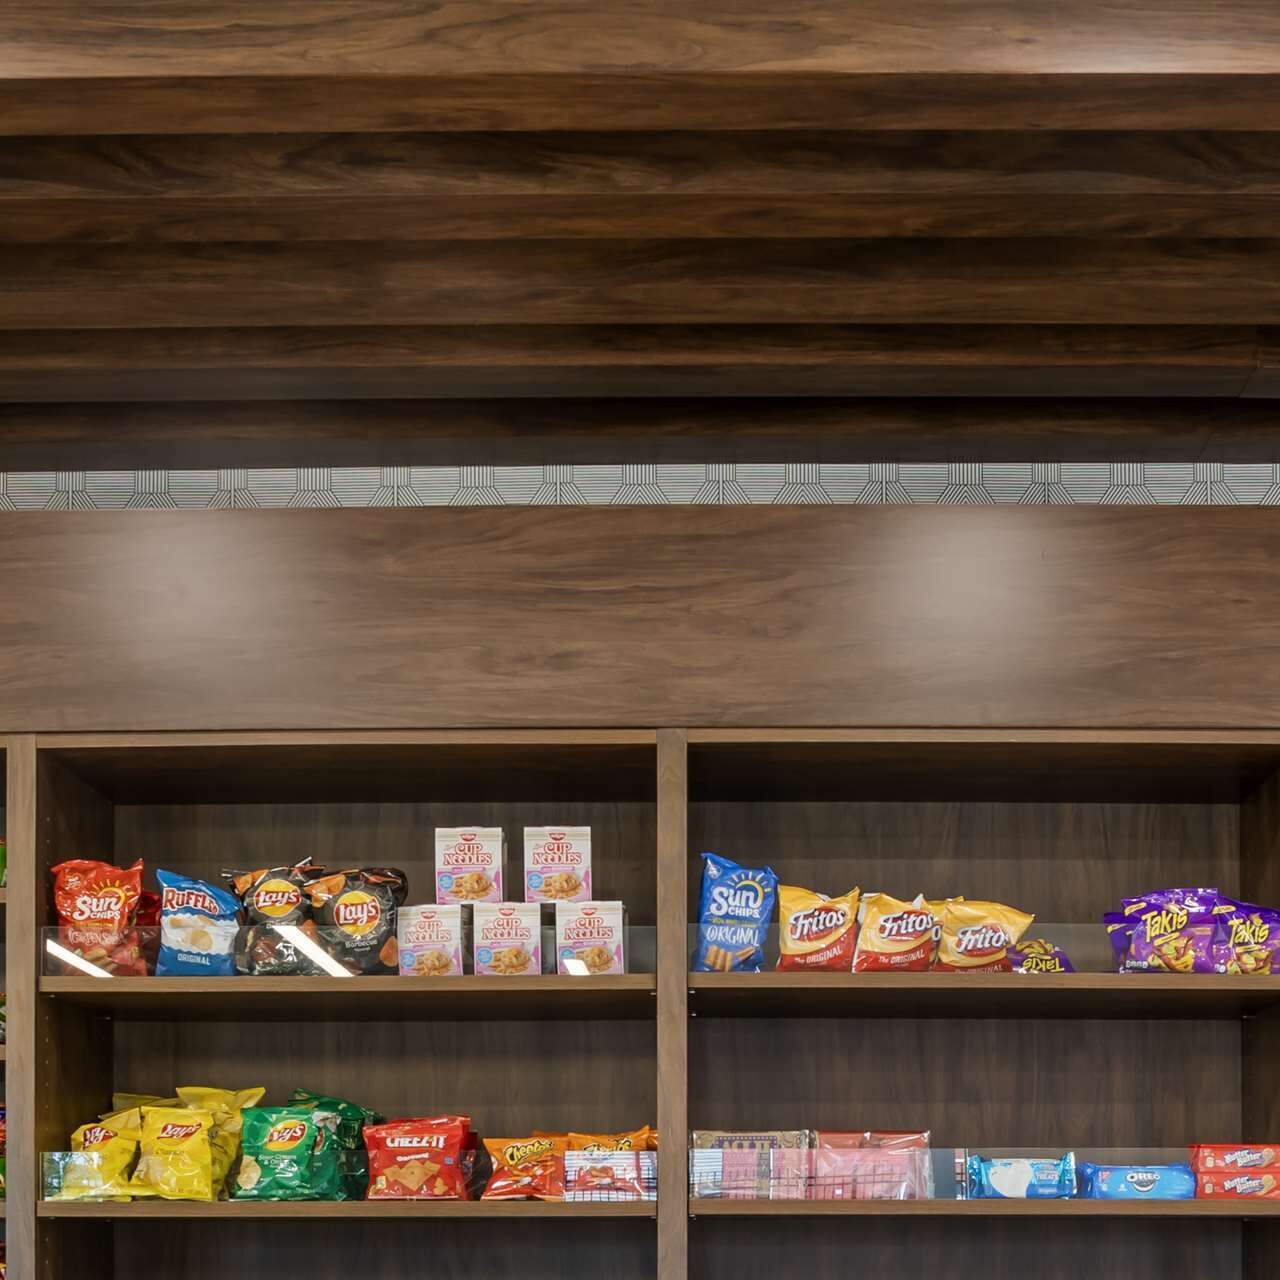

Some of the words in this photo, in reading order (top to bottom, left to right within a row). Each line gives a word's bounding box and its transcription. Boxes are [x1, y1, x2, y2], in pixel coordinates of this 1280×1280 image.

[455, 843, 482, 853] CUP
[544, 842, 572, 853] CUP
[73, 893, 122, 920] Sun
[258, 890, 299, 907] Lay's
[709, 886, 762, 916] Sun
[91, 910, 121, 920] CHIPS
[339, 900, 379, 925] Lay's
[728, 906, 761, 918] CHIPS
[790, 908, 846, 940] Fritos
[879, 911, 934, 940] Fritos
[1140, 908, 1188, 943] Takis
[706, 925, 760, 947] ORIGINAL
[806, 945, 843, 964] ORIGINAL
[1126, 1171, 1161, 1182] OREO
